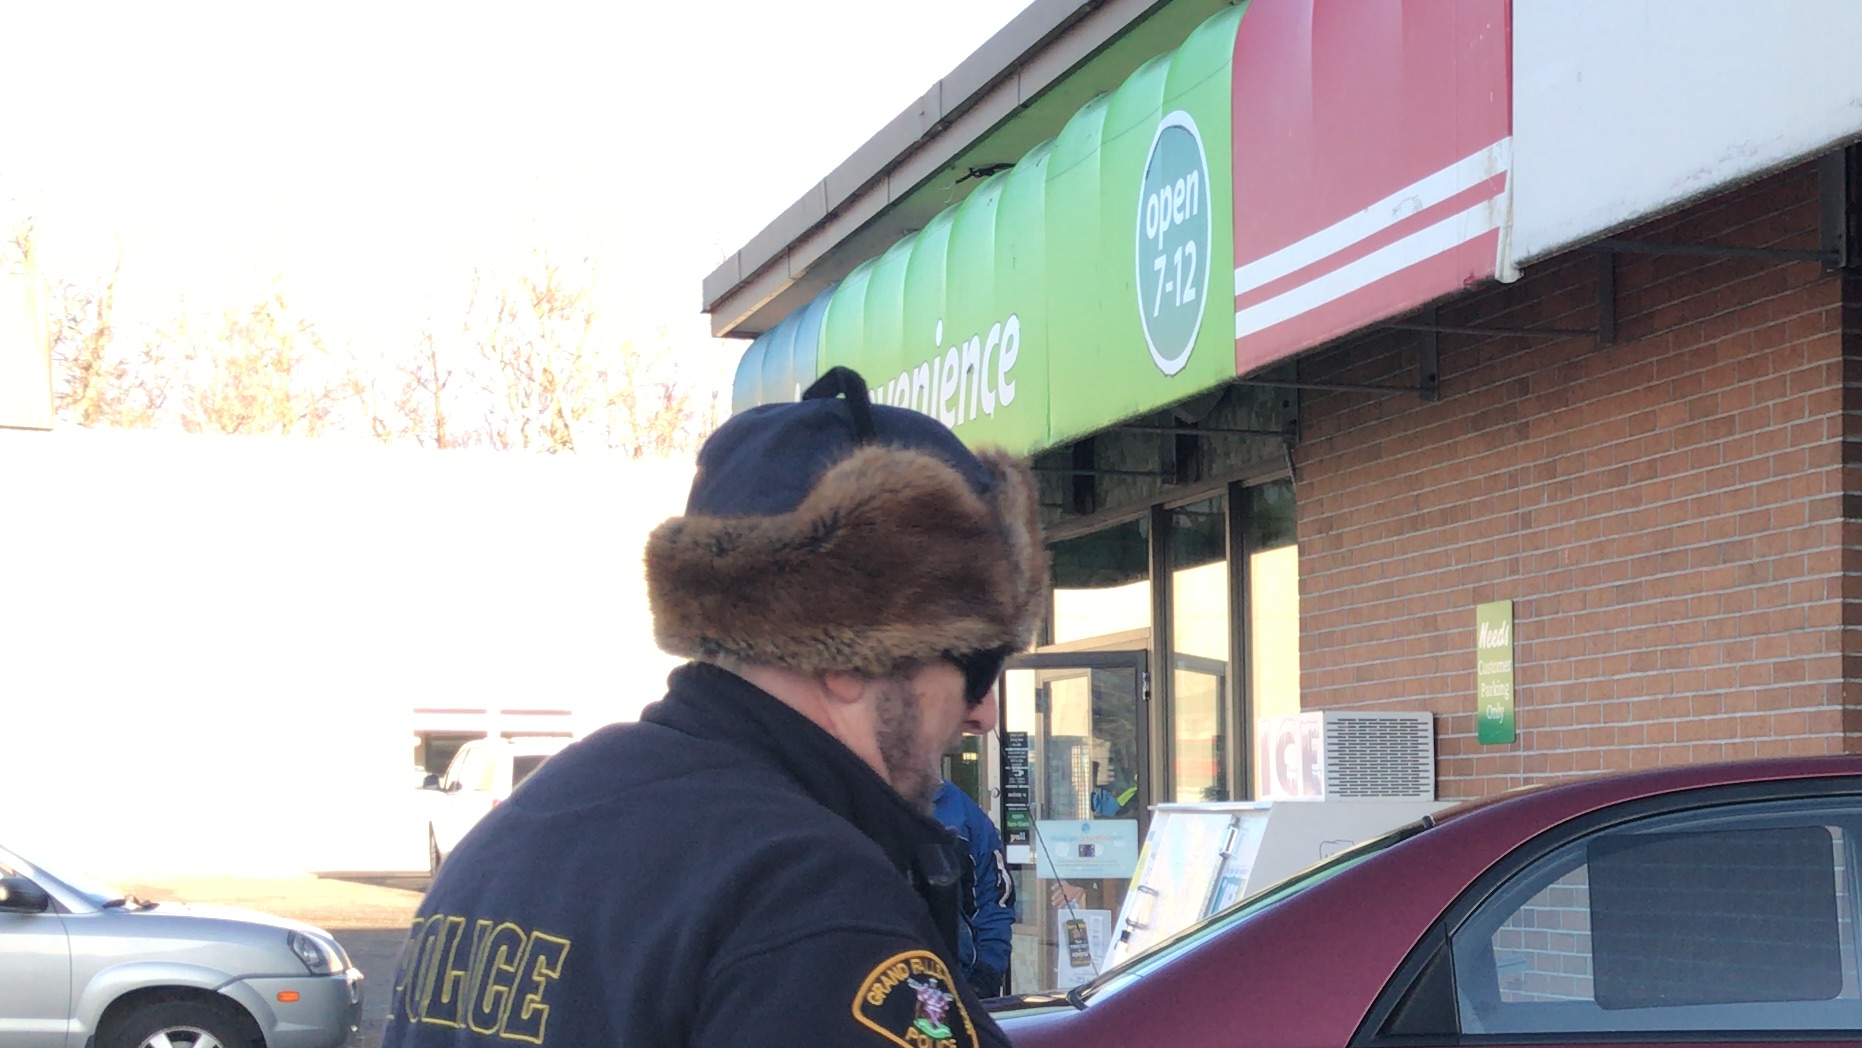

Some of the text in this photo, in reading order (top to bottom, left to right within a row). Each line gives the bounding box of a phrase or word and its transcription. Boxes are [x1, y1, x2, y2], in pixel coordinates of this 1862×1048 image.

[1146, 169, 1199, 251] open
[1153, 240, 1197, 318] 7-12
[1479, 620, 1510, 649] Needs
[1478, 660, 1512, 676] Customer
[1481, 682, 1510, 701] Parking
[1486, 703, 1505, 725] Only
[1260, 719, 1323, 797] ICE
[867, 963, 909, 1006] GRAND
